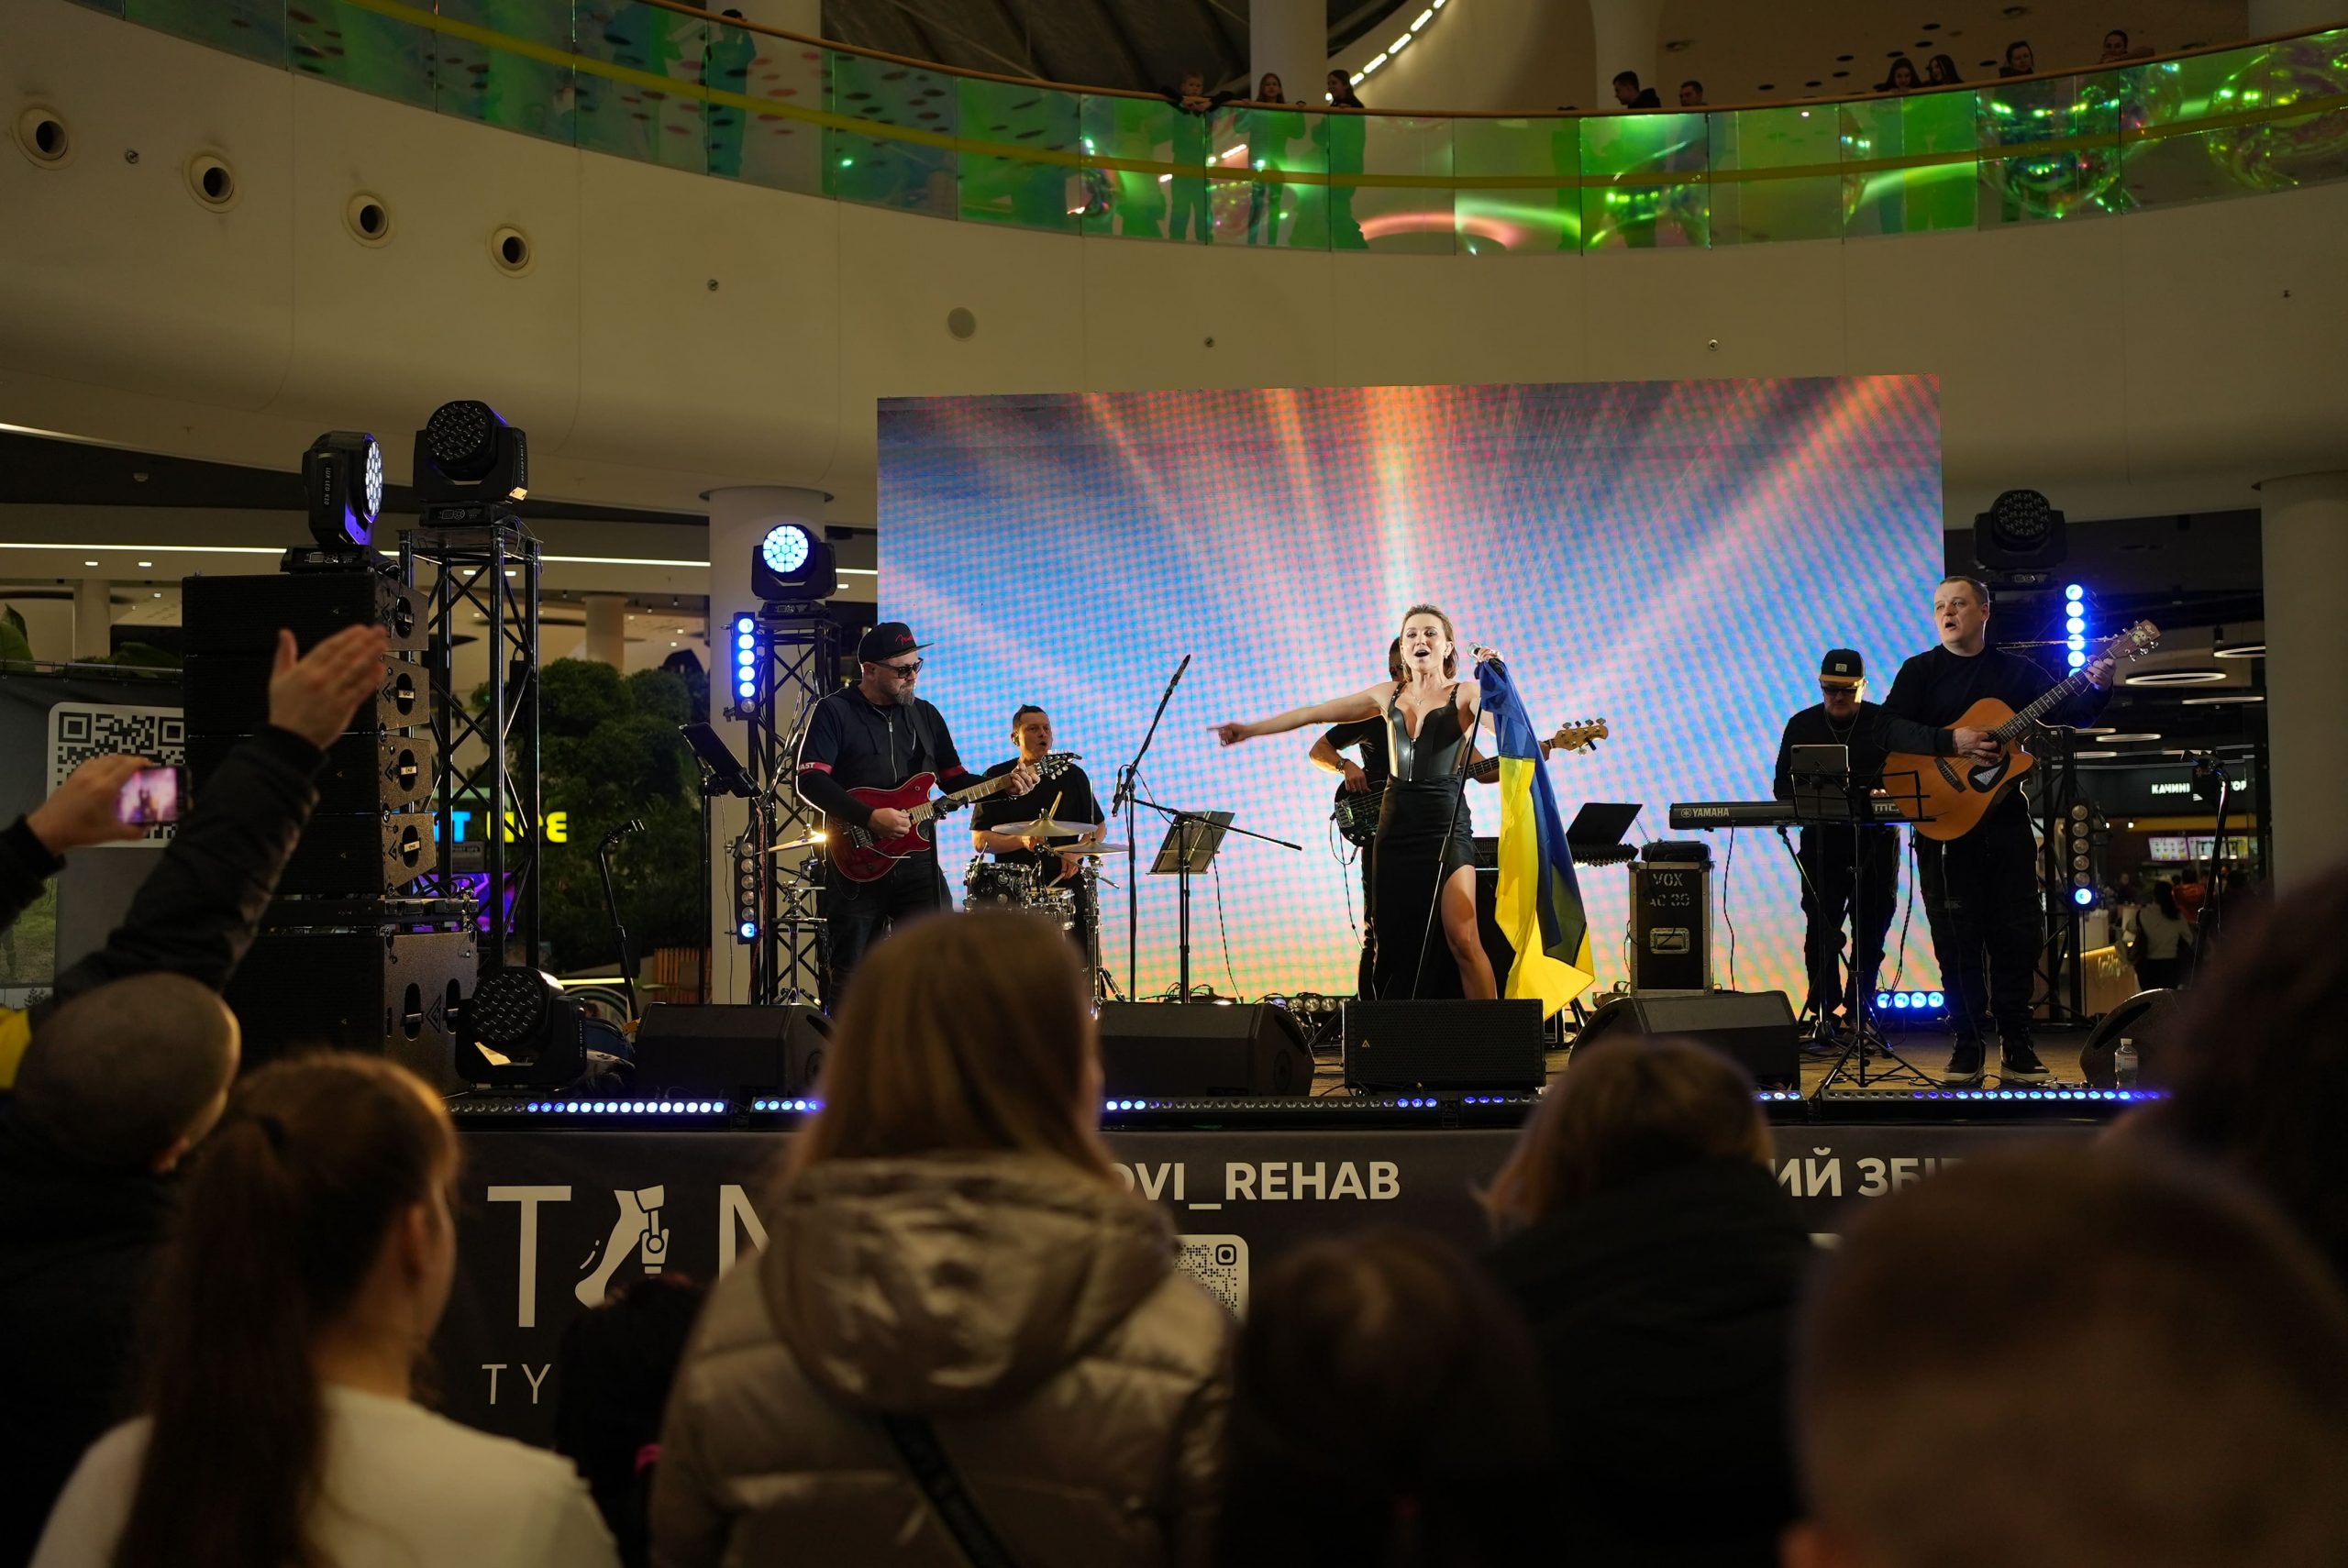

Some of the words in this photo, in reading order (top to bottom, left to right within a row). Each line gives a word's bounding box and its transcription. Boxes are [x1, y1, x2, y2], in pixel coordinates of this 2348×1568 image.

[2151, 783, 2190, 794] КАЧИНІ
[1692, 808, 1730, 817] YAMAHA
[1652, 873, 1684, 887] VOX
